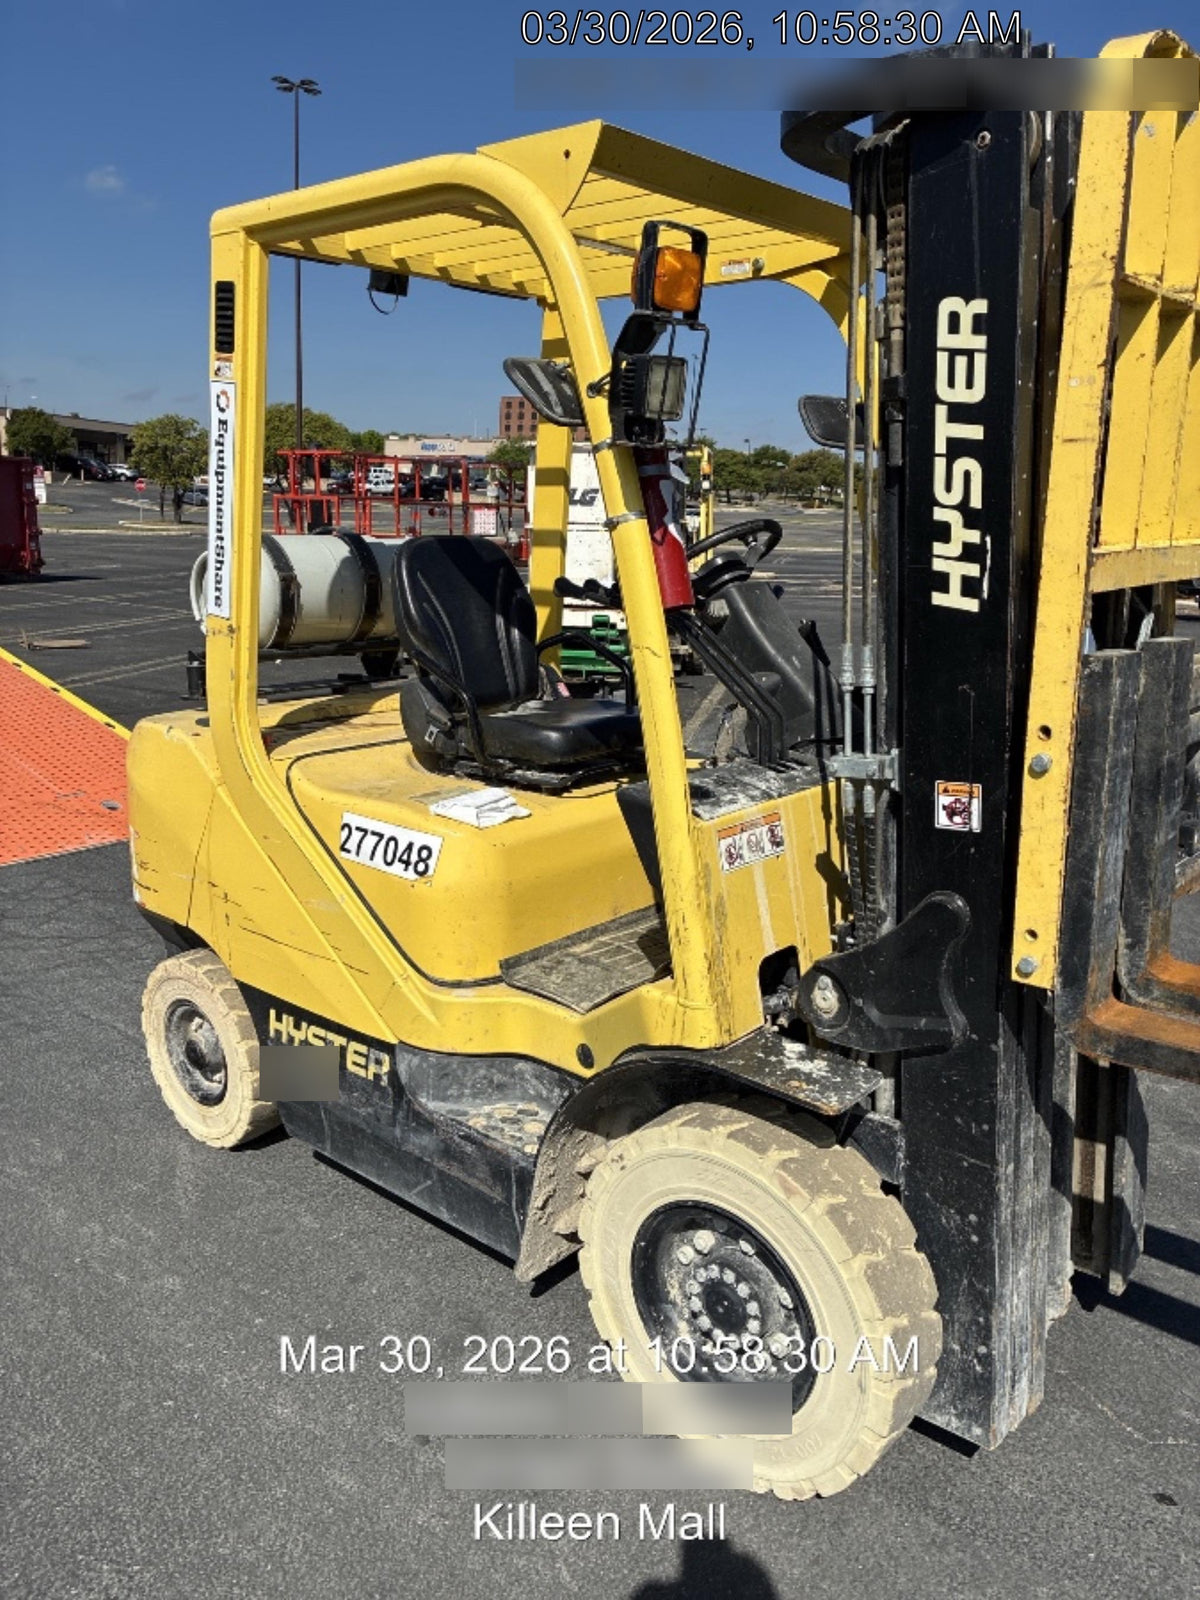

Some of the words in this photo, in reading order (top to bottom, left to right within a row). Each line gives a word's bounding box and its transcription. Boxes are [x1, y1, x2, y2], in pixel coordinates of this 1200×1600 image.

[931, 296, 988, 613] HYSTER
[214, 418, 228, 609] EquipmentShare
[568, 488, 600, 507] LG
[340, 822, 433, 877] 277048
[269, 1008, 390, 1087] HYSTER
